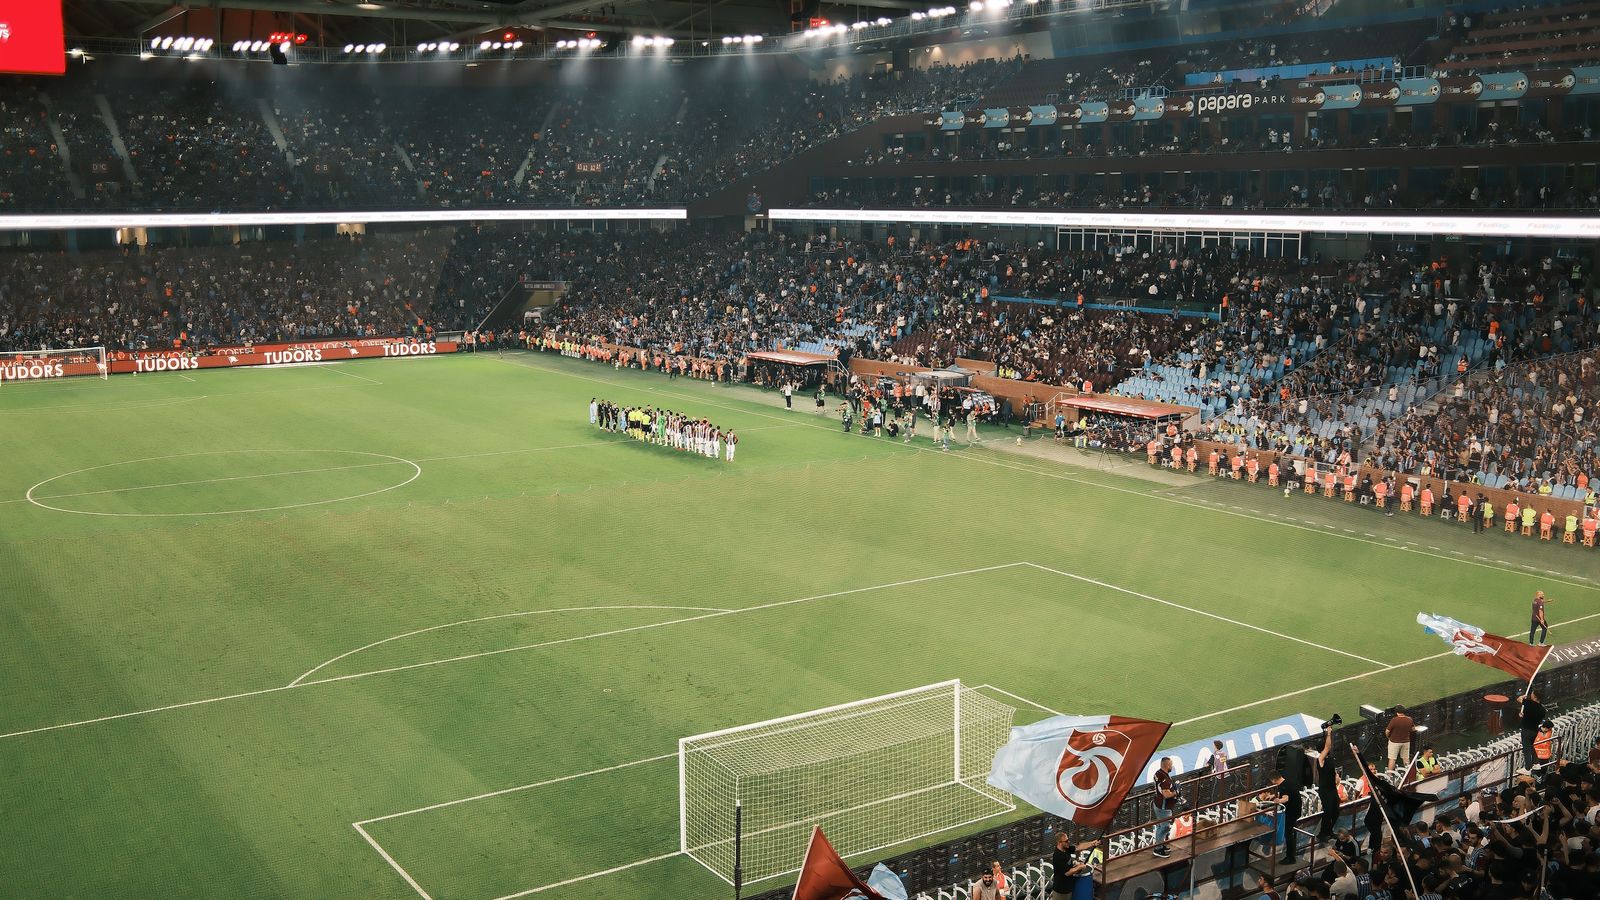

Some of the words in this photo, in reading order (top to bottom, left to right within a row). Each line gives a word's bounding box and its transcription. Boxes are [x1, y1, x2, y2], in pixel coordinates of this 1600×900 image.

[1198, 93, 1252, 114] papara
[1254, 95, 1286, 105] PARK
[383, 342, 437, 356] TUDORS
[264, 350, 322, 364] TUDORS
[135, 357, 199, 372] TUDORS
